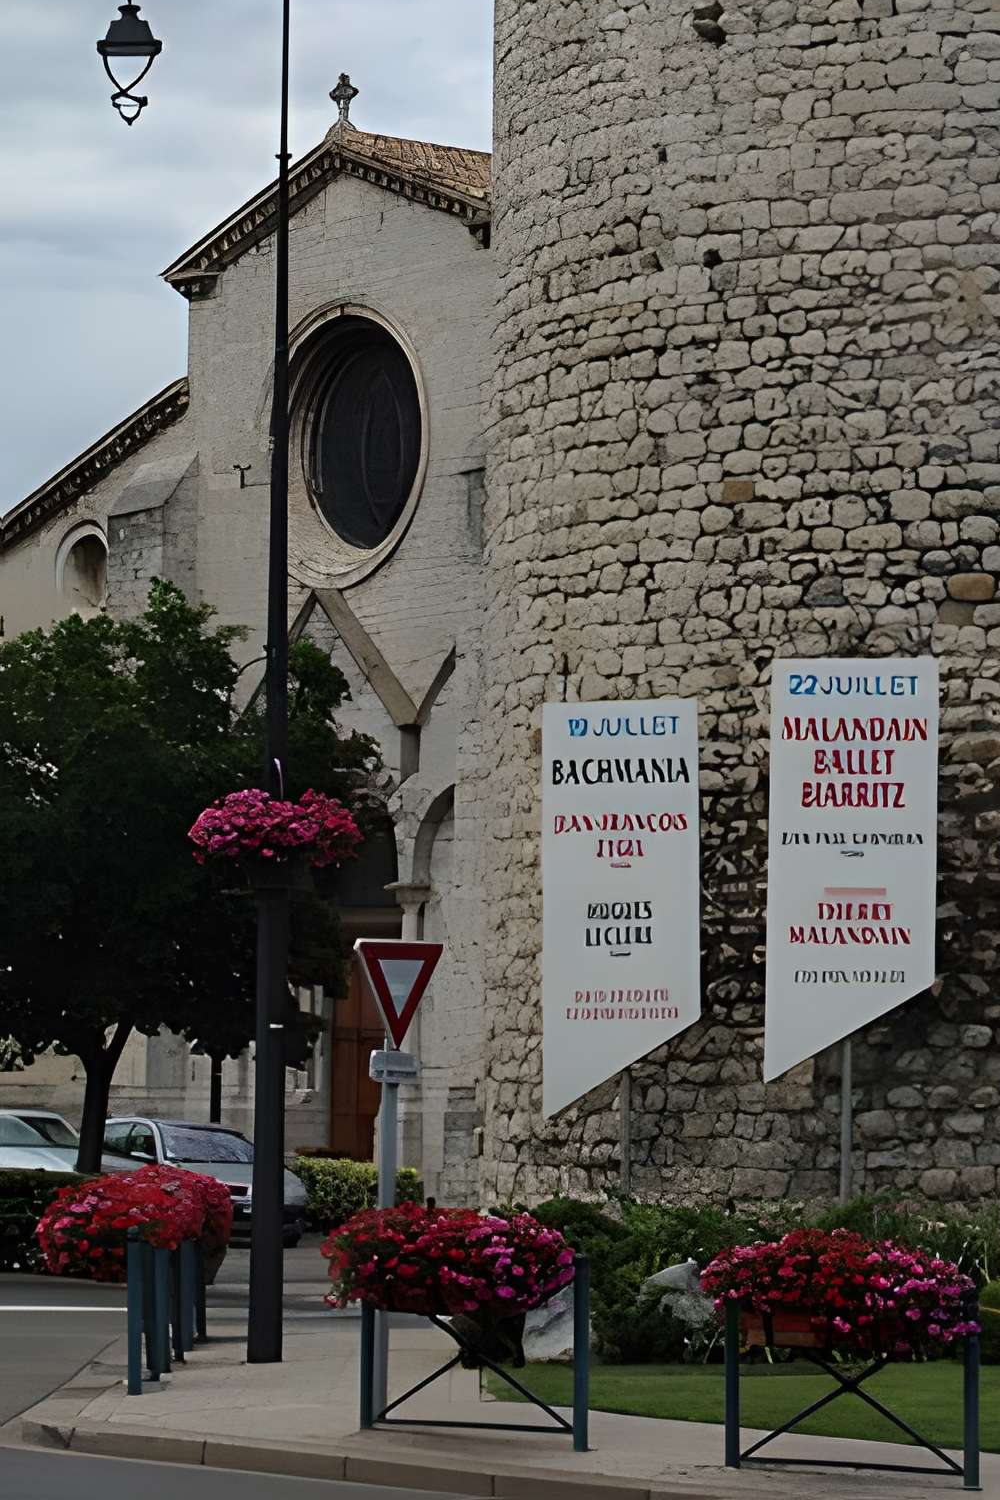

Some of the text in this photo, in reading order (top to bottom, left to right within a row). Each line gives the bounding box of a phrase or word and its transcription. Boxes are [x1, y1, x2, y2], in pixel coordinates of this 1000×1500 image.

[789, 674, 918, 696] 22 JUILLET
[814, 749, 896, 775] BALLET
[801, 782, 906, 808] BIARRITZ
